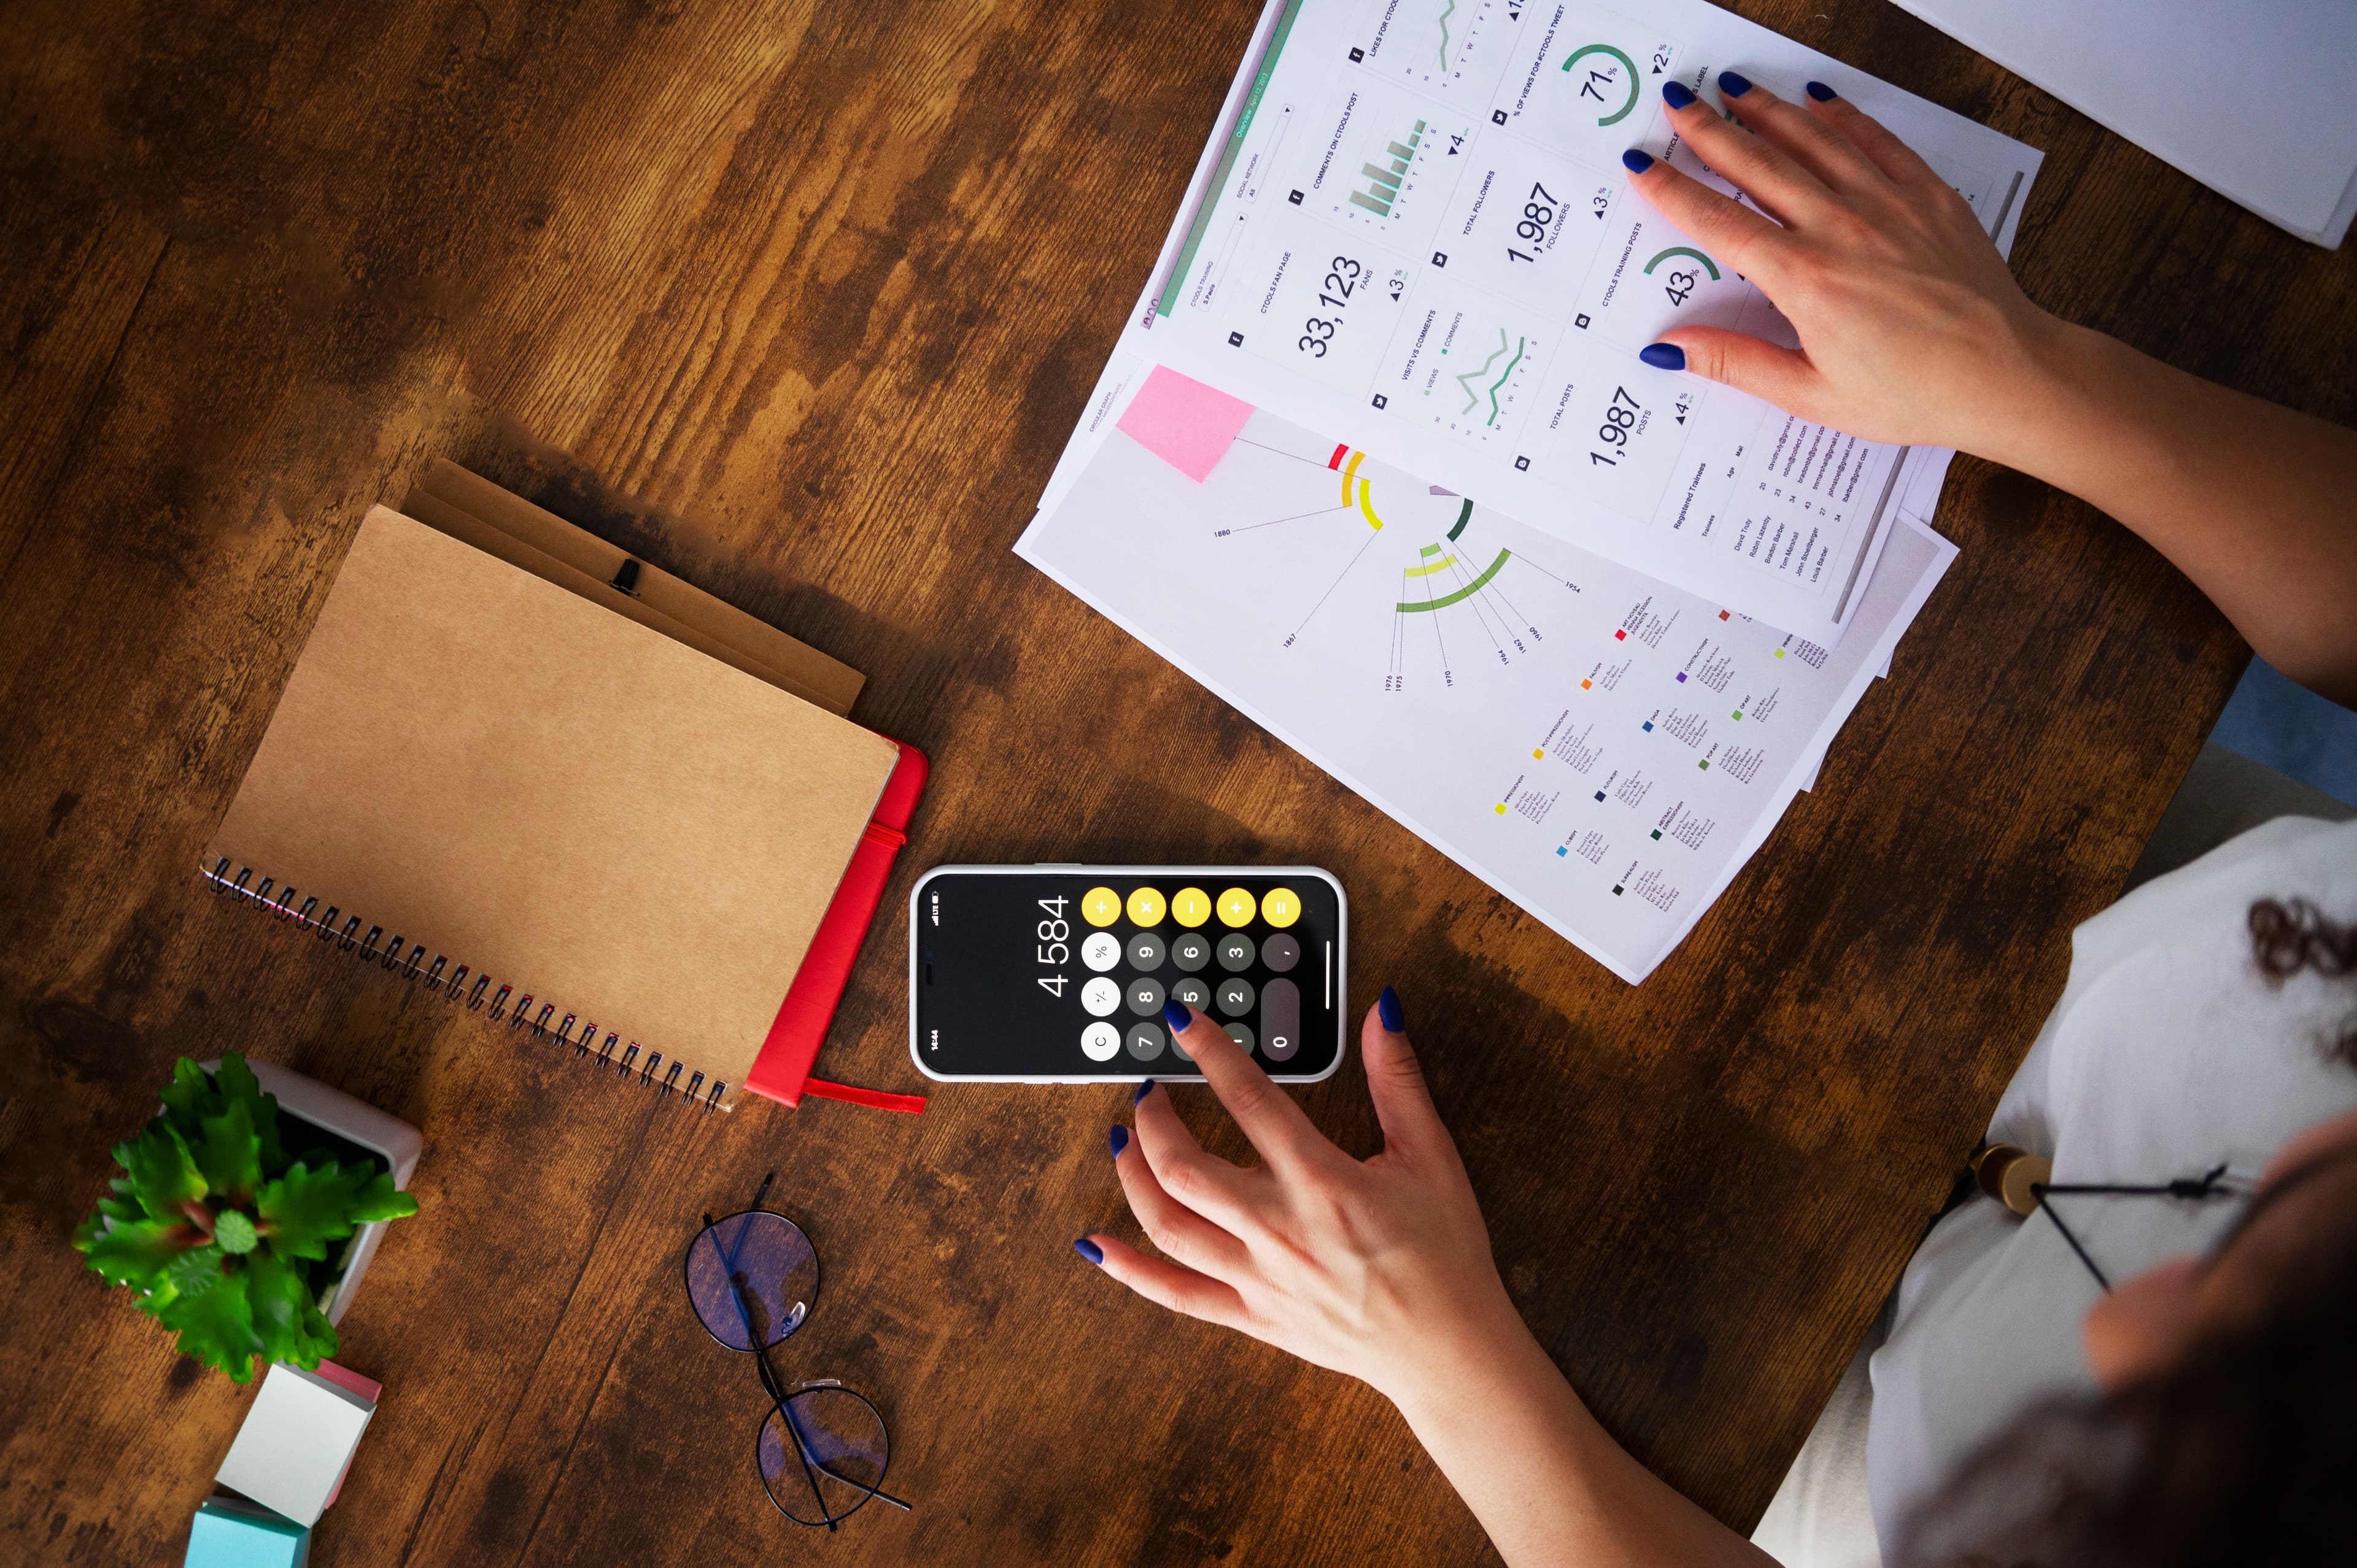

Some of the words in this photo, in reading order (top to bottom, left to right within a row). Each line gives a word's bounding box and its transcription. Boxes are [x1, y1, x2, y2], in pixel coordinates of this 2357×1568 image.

[1550, 4, 1565, 28] TWEET
[1369, 36, 1382, 57] LIKES
[1378, 21, 1389, 37] FOR
[1537, 29, 1555, 61] #CTOOLS
[1530, 61, 1541, 77] FOR
[1653, 53, 1669, 68] 2
[1520, 77, 1535, 98] VIEWS
[1694, 66, 1709, 88] LABEL
[1346, 91, 1358, 112] POST
[1517, 99, 1524, 109] OF
[1236, 109, 1252, 138] Overview
[1334, 111, 1350, 139] CTOOLS
[1330, 139, 1339, 150] ON
[1664, 131, 1679, 162] ARTICLE
[1236, 180, 1248, 199] SOCIAL
[1244, 153, 1259, 179] NETWORK
[1313, 150, 1334, 190] COMMENTS
[1463, 214, 1477, 235] TOTAL
[1473, 170, 1495, 213] FOLLOWERS
[1593, 196, 1608, 209] 3
[1507, 181, 1558, 263] 1,987
[1546, 203, 1570, 250] FOLLOWERS
[1602, 279, 1618, 307] CTOOLS
[1614, 245, 1632, 277] TRAINING
[1628, 222, 1642, 246] POSTS
[1190, 285, 1203, 307] CTOOLS
[1199, 261, 1213, 285] TRAINING
[1261, 286, 1276, 314] CTOOLS
[1272, 271, 1283, 287] FAN
[1278, 251, 1291, 272] PAGE
[1360, 269, 1373, 290] FANS
[1389, 279, 1404, 291] 3
[1298, 256, 1361, 358] 33,123
[1415, 309, 1436, 349] COMMENTS
[1444, 312, 1463, 347] COMMENTS
[1411, 349, 1420, 358] VS
[1401, 359, 1415, 380] VISITS
[1426, 368, 1439, 388] VIEWS
[1089, 407, 1104, 432] CIRCULAR
[1101, 392, 1112, 408] GRAPH
[1549, 408, 1564, 430] TOTAL
[1560, 384, 1574, 407] POSTS
[1675, 402, 1689, 414] 4
[1590, 385, 1641, 466] 1,987
[1636, 409, 1651, 436] POSTS
[1701, 515, 1715, 537] Trainees
[1735, 445, 1744, 457] Mail
[1733, 534, 1746, 552] David
[1741, 518, 1753, 533] Truty
[1759, 482, 1767, 491] 20
[1768, 415, 1795, 471] davidtruty@gmail.co
[1764, 543, 1778, 564] Bradon
[1773, 522, 1785, 543] Barber
[1797, 425, 1825, 484] bradonbb@gmail.co
[1673, 492, 1693, 530] Registered
[1689, 462, 1706, 491] Trainees
[1214, 529, 1231, 538] 1880
[1749, 540, 1761, 558] Robin
[1756, 515, 1771, 540] Lazenby
[1774, 489, 1781, 497] 23
[1779, 557, 1789, 570] Tom
[1785, 531, 1799, 557] Marshall
[1805, 501, 1812, 510] 43
[1795, 562, 1805, 577] John
[1819, 507, 1826, 516] 27
[1810, 566, 1821, 583] Louis
[1816, 546, 1829, 566] Barber
[1283, 633, 1296, 648] 1867
[1529, 627, 1542, 642] 1960
[1498, 649, 1509, 665] 1964
[1514, 638, 1527, 654] 1962
[1684, 638, 1709, 671] CONSTRUCTIVISM
[1444, 670, 1453, 687] 1970
[1650, 709, 1661, 721] DADA
[1603, 770, 1619, 790] FUTURISM
[1658, 806, 1673, 827] ABSTRACT
[1038, 895, 1069, 964] 584
[1139, 947, 1153, 957] 9
[1184, 948, 1198, 958] 6
[1229, 948, 1243, 957] 3
[1139, 992, 1153, 1002] 8
[1184, 992, 1198, 1002] 5
[1229, 992, 1242, 1002] 2
[1096, 1037, 1106, 1046] C
[1139, 1037, 1152, 1046] 7
[1273, 1037, 1287, 1048] 0
